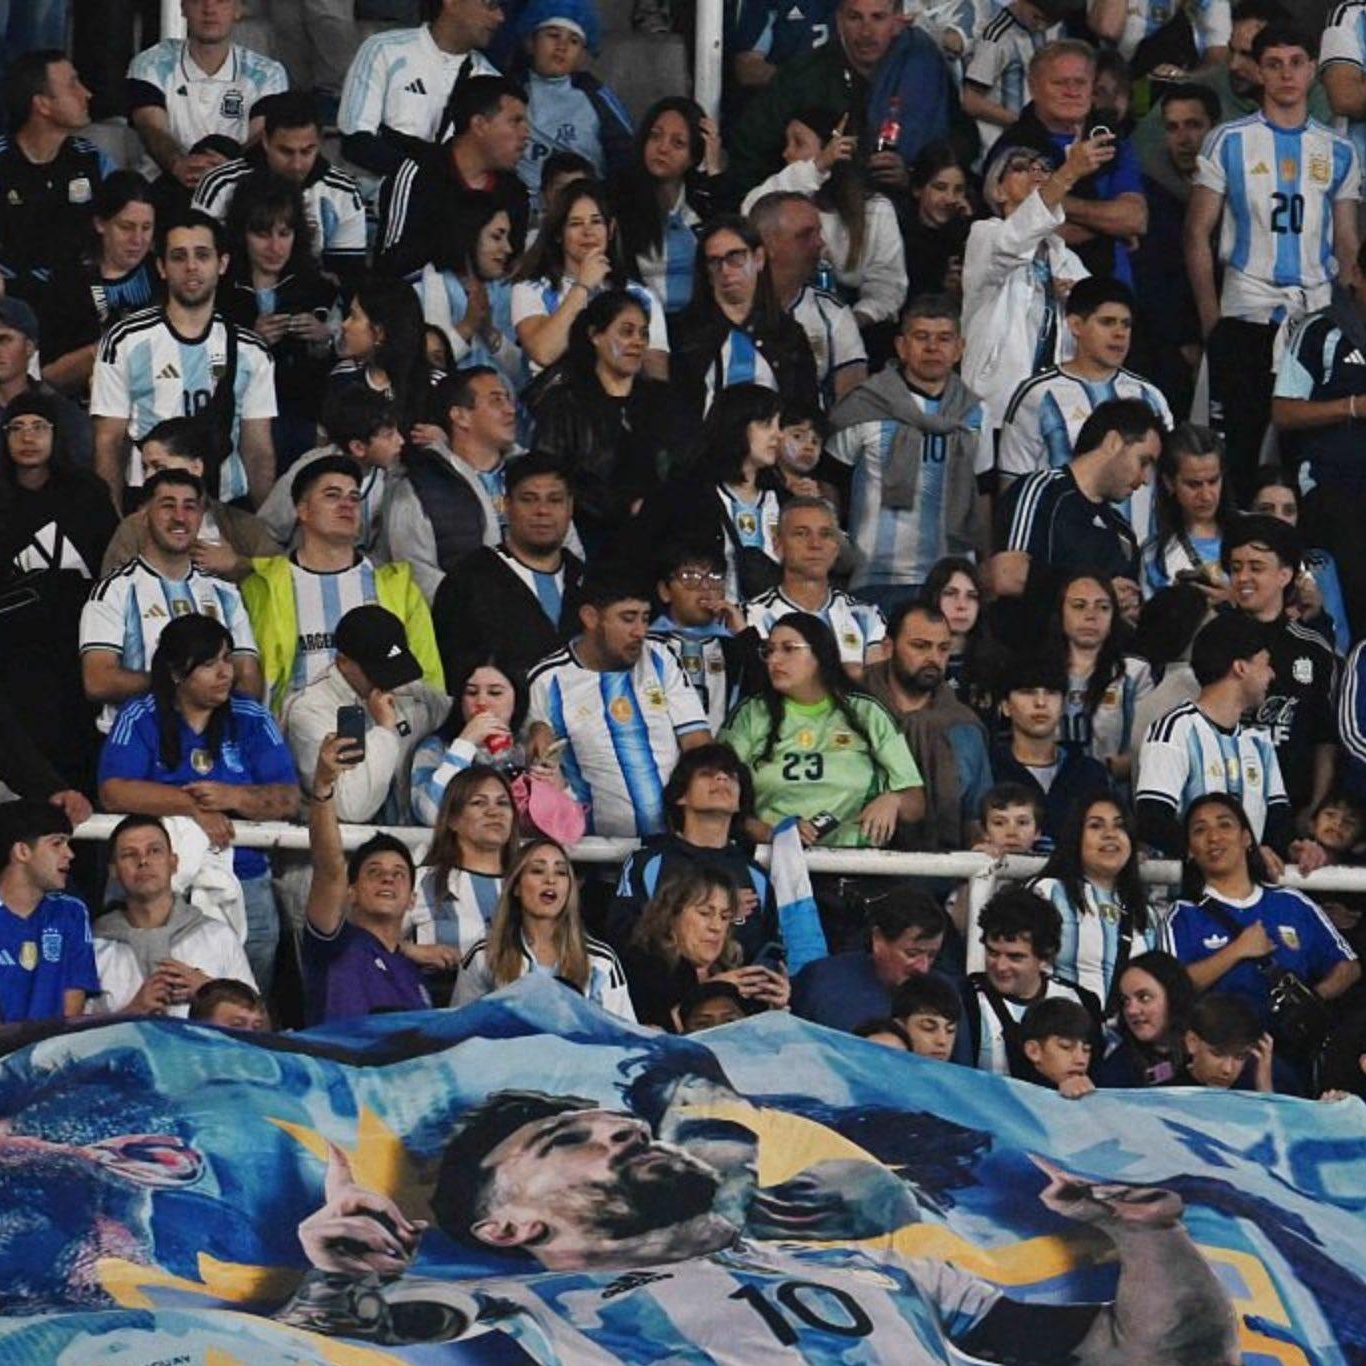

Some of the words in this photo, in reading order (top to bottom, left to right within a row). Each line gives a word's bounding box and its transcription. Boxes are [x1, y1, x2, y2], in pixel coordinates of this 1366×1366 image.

[1269, 191, 1305, 235] 20
[923, 429, 947, 464] 10
[781, 751, 825, 782] 23
[727, 1279, 875, 1347] 10
